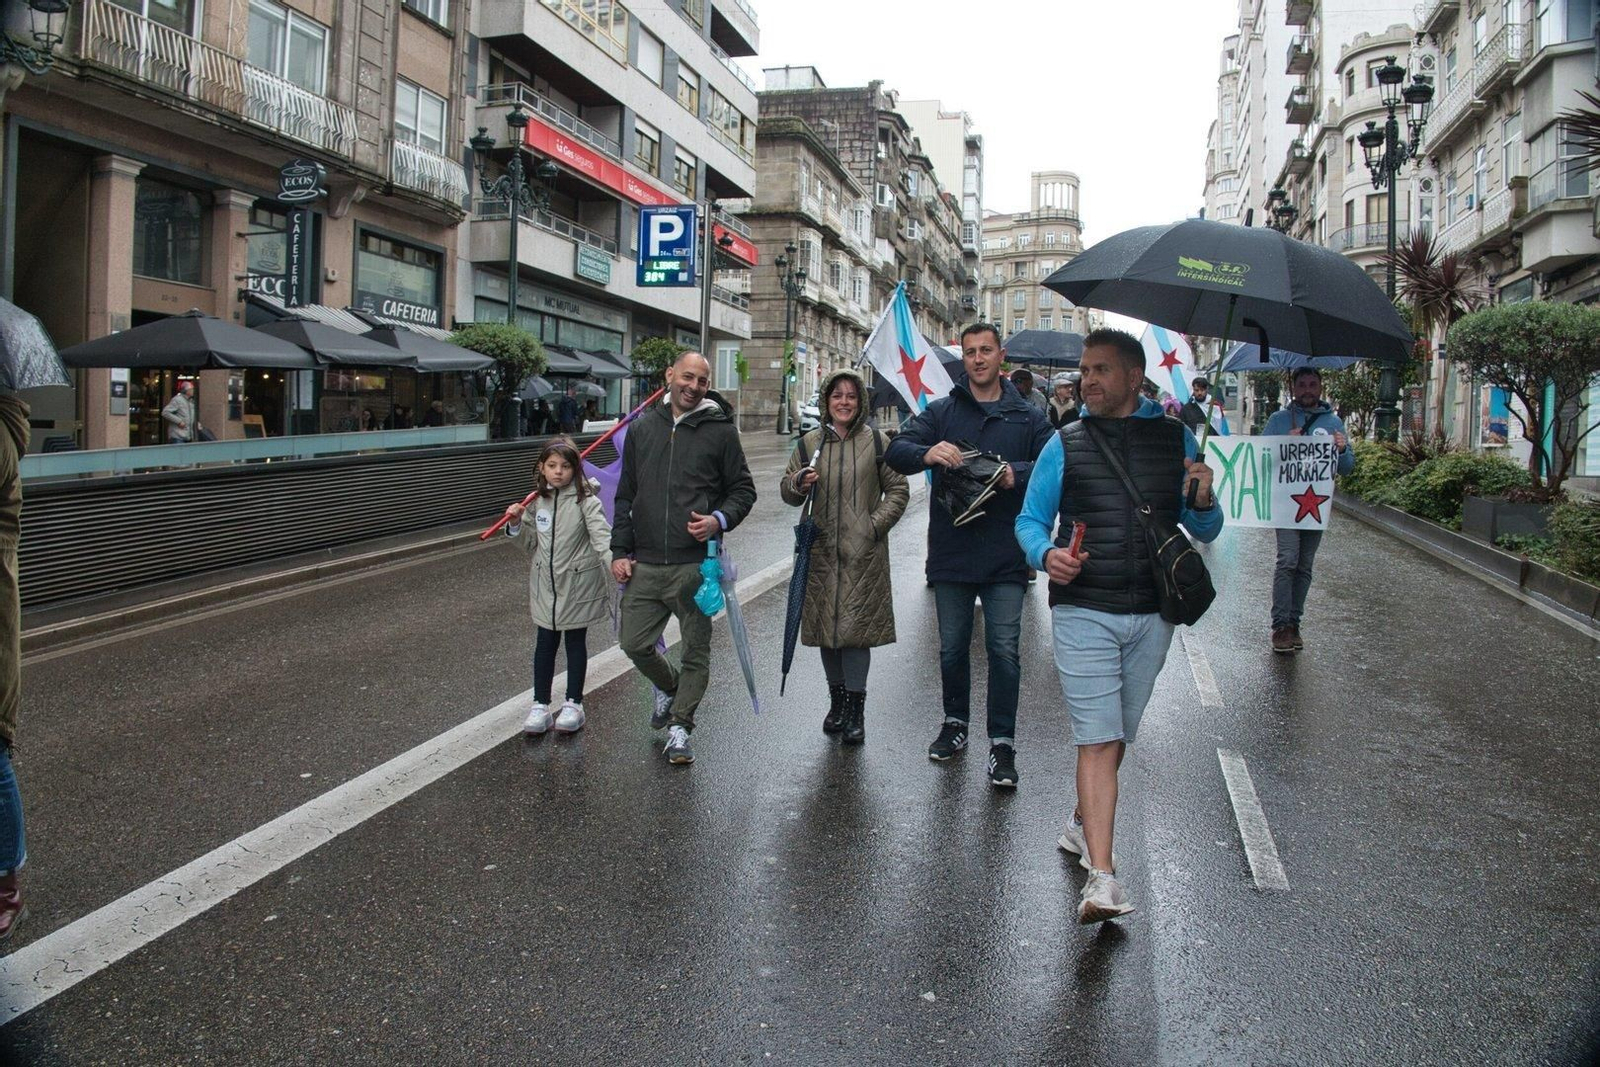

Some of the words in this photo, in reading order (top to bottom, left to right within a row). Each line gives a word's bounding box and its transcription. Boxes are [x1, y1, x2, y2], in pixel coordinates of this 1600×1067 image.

[284, 175, 313, 187] ECOS
[649, 214, 685, 257] P
[290, 213, 301, 305] CAFETERIA
[653, 261, 680, 270] LIBRE
[1177, 270, 1245, 286] INTERSINDICAL
[382, 299, 437, 325] CAFETERIA
[544, 296, 555, 308] MC
[556, 298, 581, 315] MUTUAL
[1279, 443, 1338, 462] URBASER
